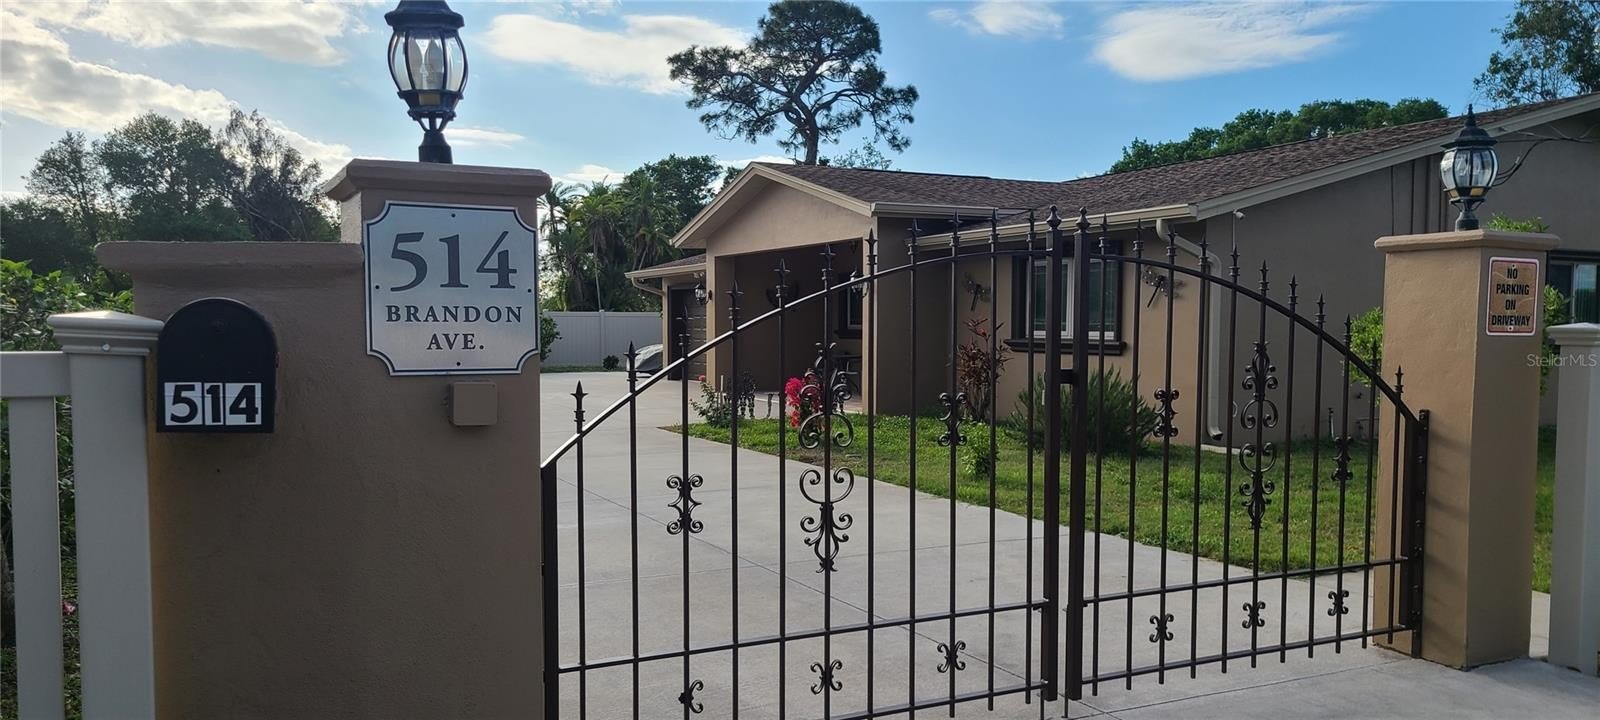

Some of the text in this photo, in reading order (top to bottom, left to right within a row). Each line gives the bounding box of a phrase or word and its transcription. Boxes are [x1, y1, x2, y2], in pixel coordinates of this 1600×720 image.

[390, 231, 518, 292] 514
[1507, 268, 1518, 280] NO
[1496, 284, 1530, 295] PARKING
[1505, 300, 1516, 310] ON
[386, 305, 522, 323] BRANDON
[1491, 315, 1531, 326] DRIVEWAY
[426, 333, 485, 350] AVE.
[169, 384, 259, 424] 514
